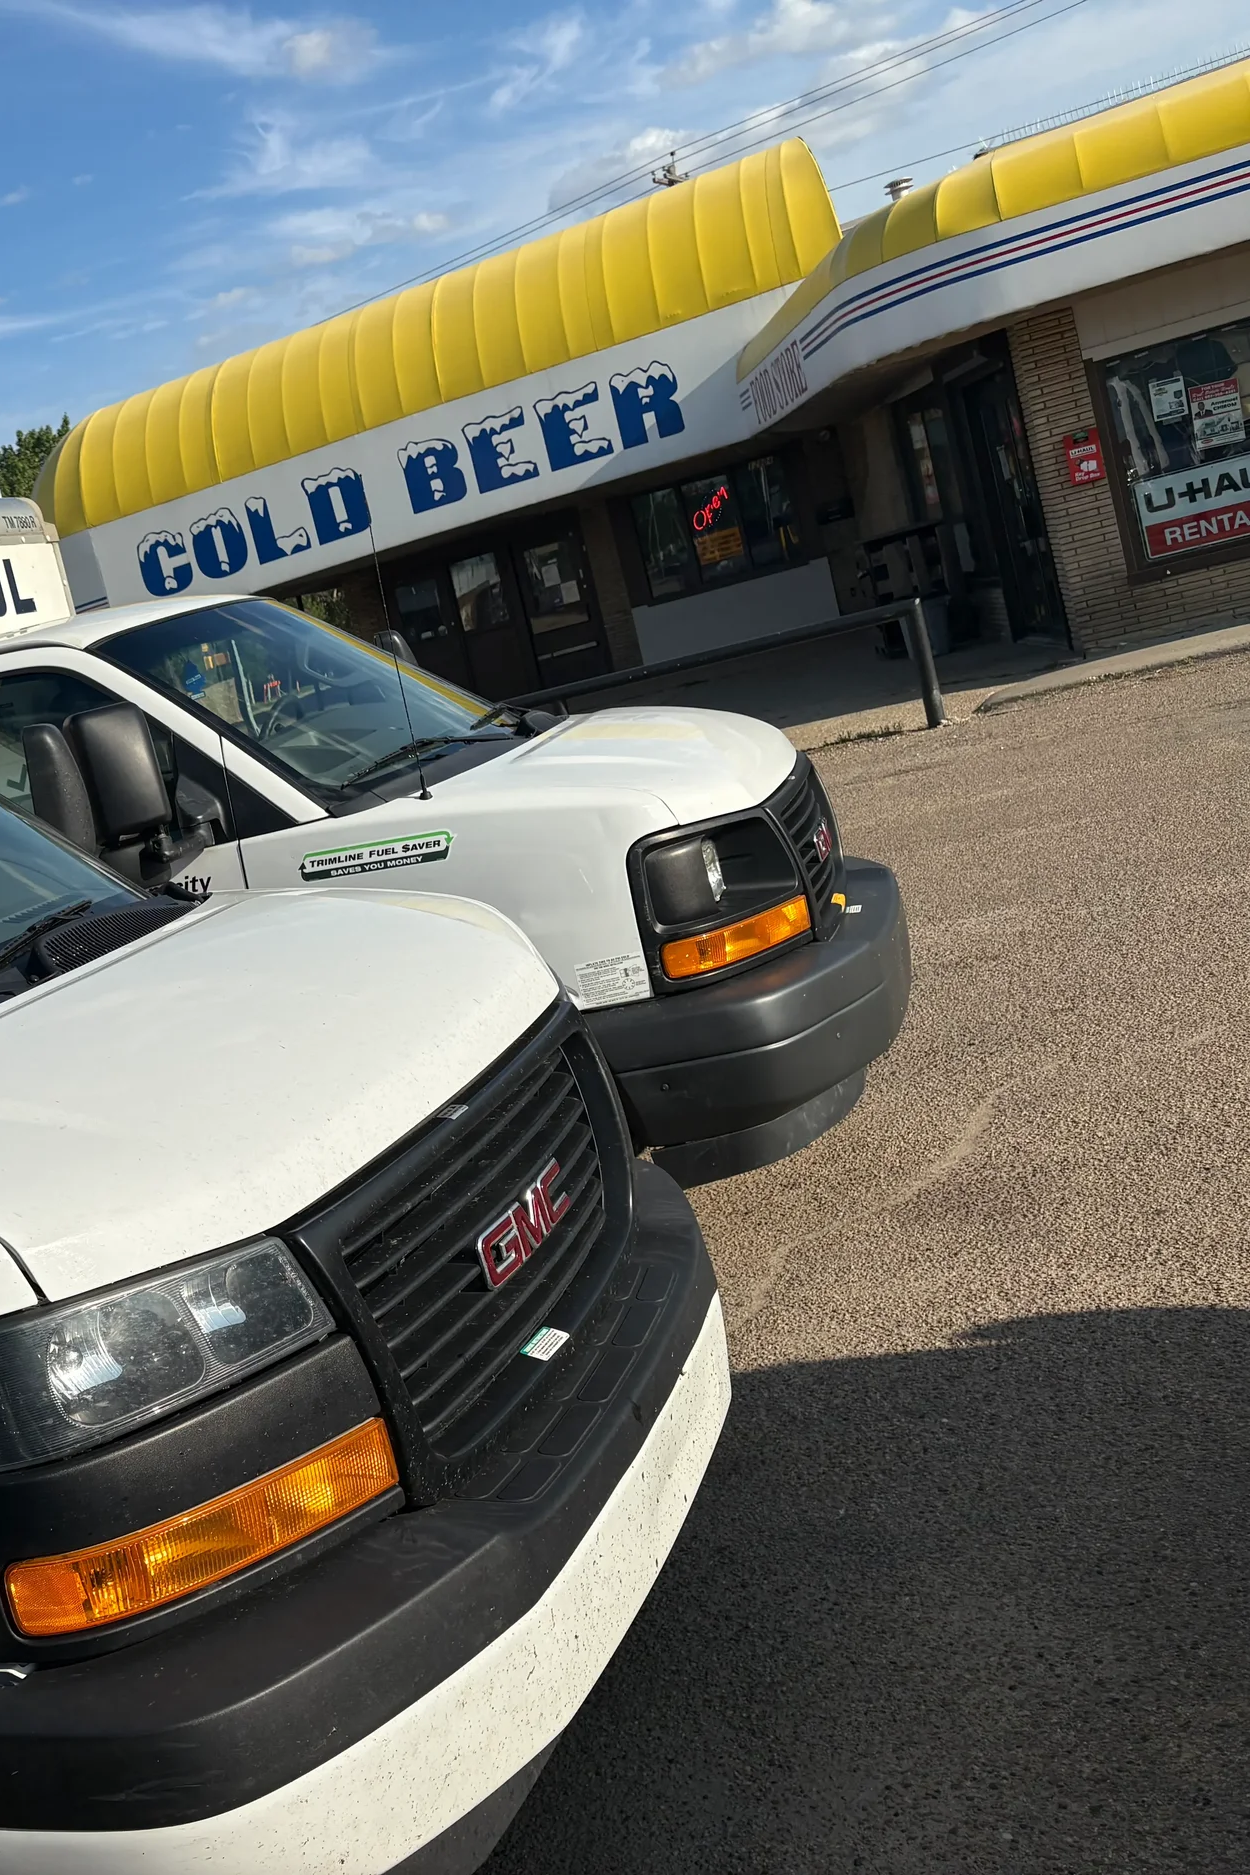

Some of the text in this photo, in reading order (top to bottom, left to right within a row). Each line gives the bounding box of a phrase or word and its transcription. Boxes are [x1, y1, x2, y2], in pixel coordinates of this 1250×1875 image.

[137, 360, 685, 597] COLD BEER
[2, 516, 16, 528] TM
[693, 486, 728, 530] Open
[309, 839, 441, 868] TRIMLINE FUEL $AVER
[330, 855, 423, 877] SAVES YOU MONEY
[475, 1157, 571, 1291] GMC
